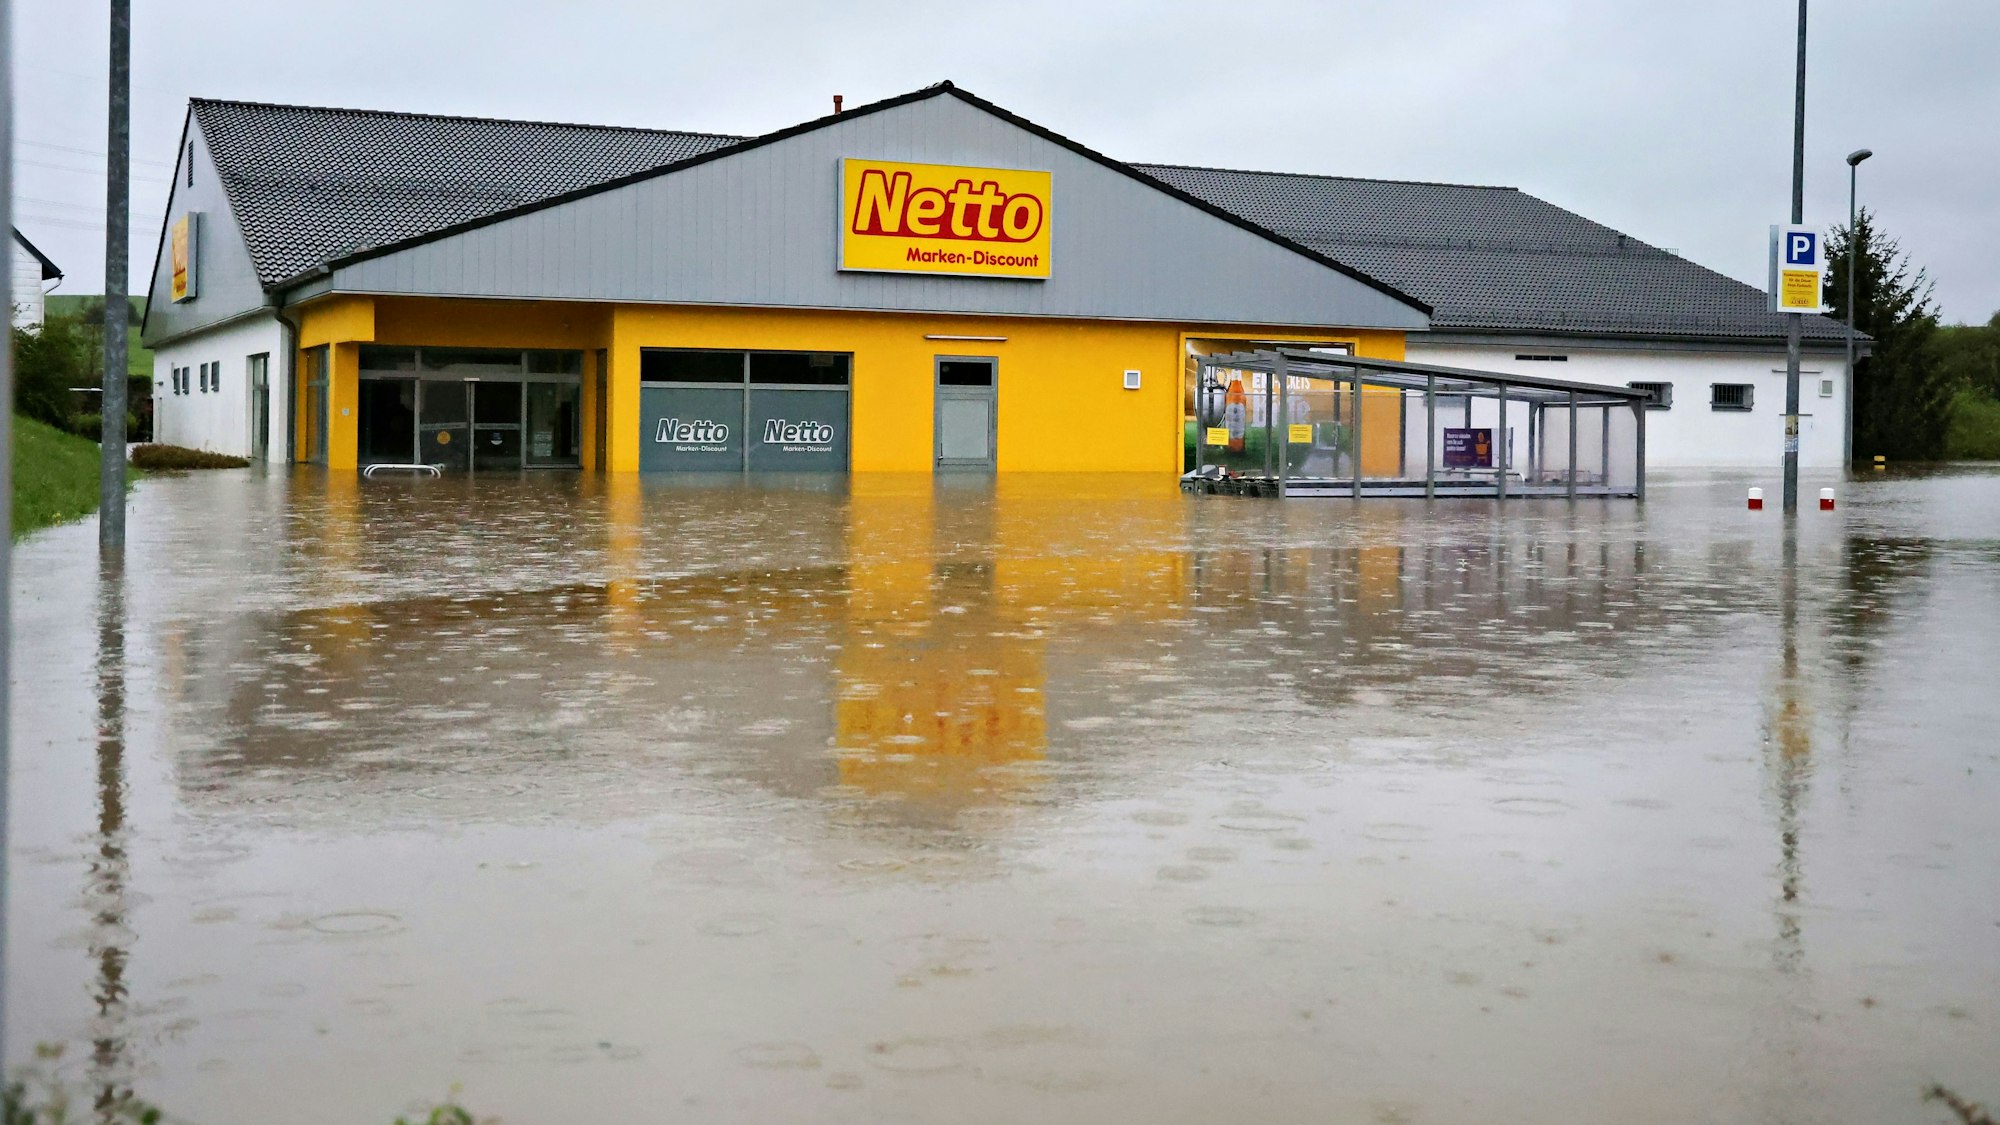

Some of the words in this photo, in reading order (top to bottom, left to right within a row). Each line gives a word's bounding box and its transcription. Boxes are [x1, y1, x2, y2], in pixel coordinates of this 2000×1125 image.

[852, 169, 1043, 243] Netto
[906, 247, 1039, 267] Marken-Discount
[1792, 235, 1811, 261] P
[655, 418, 729, 443] Netto
[763, 419, 834, 444] Netto
[783, 445, 832, 453] Marken-Discount
